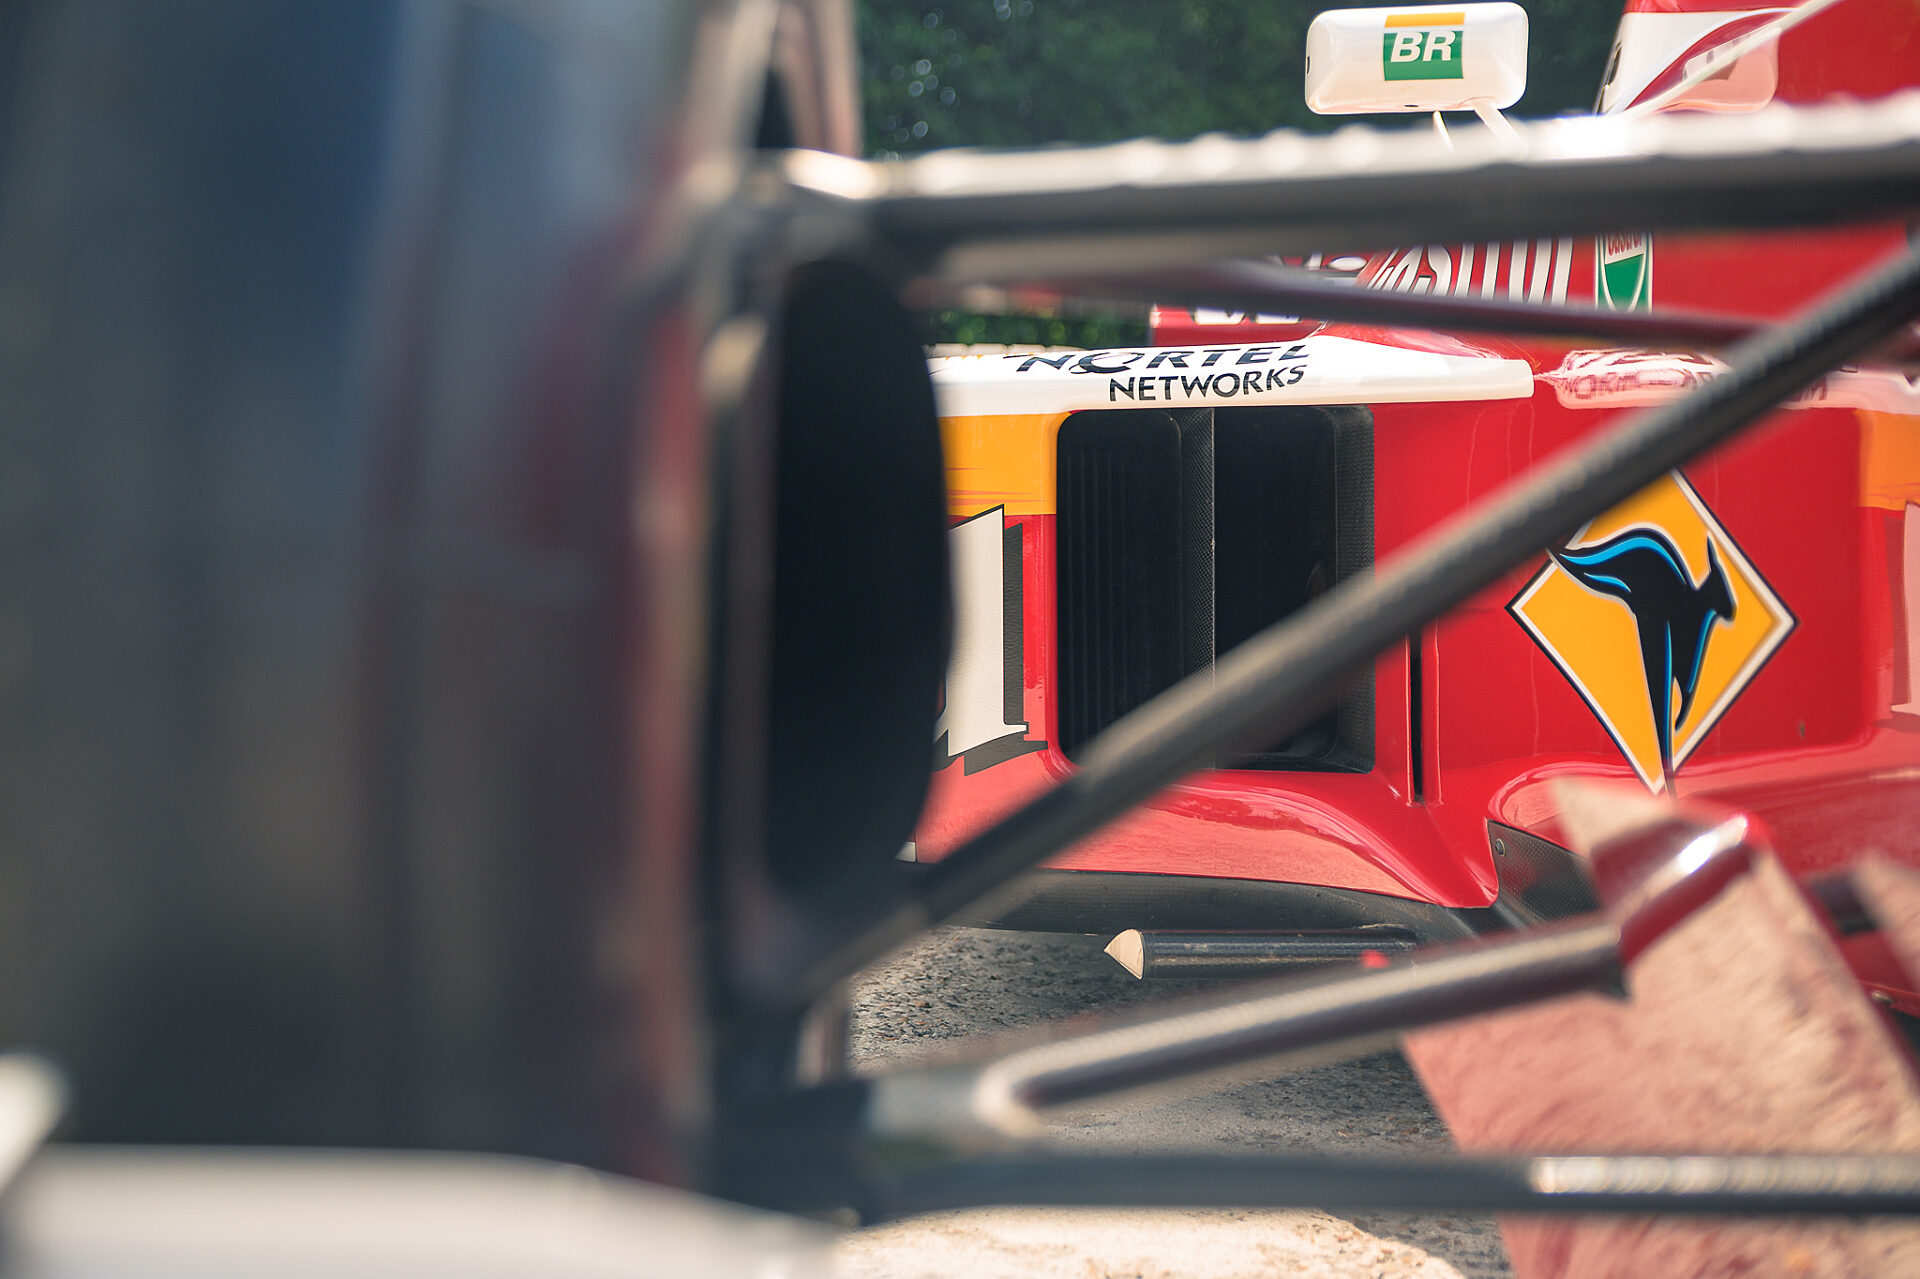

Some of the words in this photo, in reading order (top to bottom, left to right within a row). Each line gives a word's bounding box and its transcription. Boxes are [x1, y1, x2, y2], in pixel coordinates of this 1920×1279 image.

[1390, 30, 1456, 62] BR
[1003, 345, 1309, 374] NORTEL
[1109, 364, 1307, 401] NETWORKS
